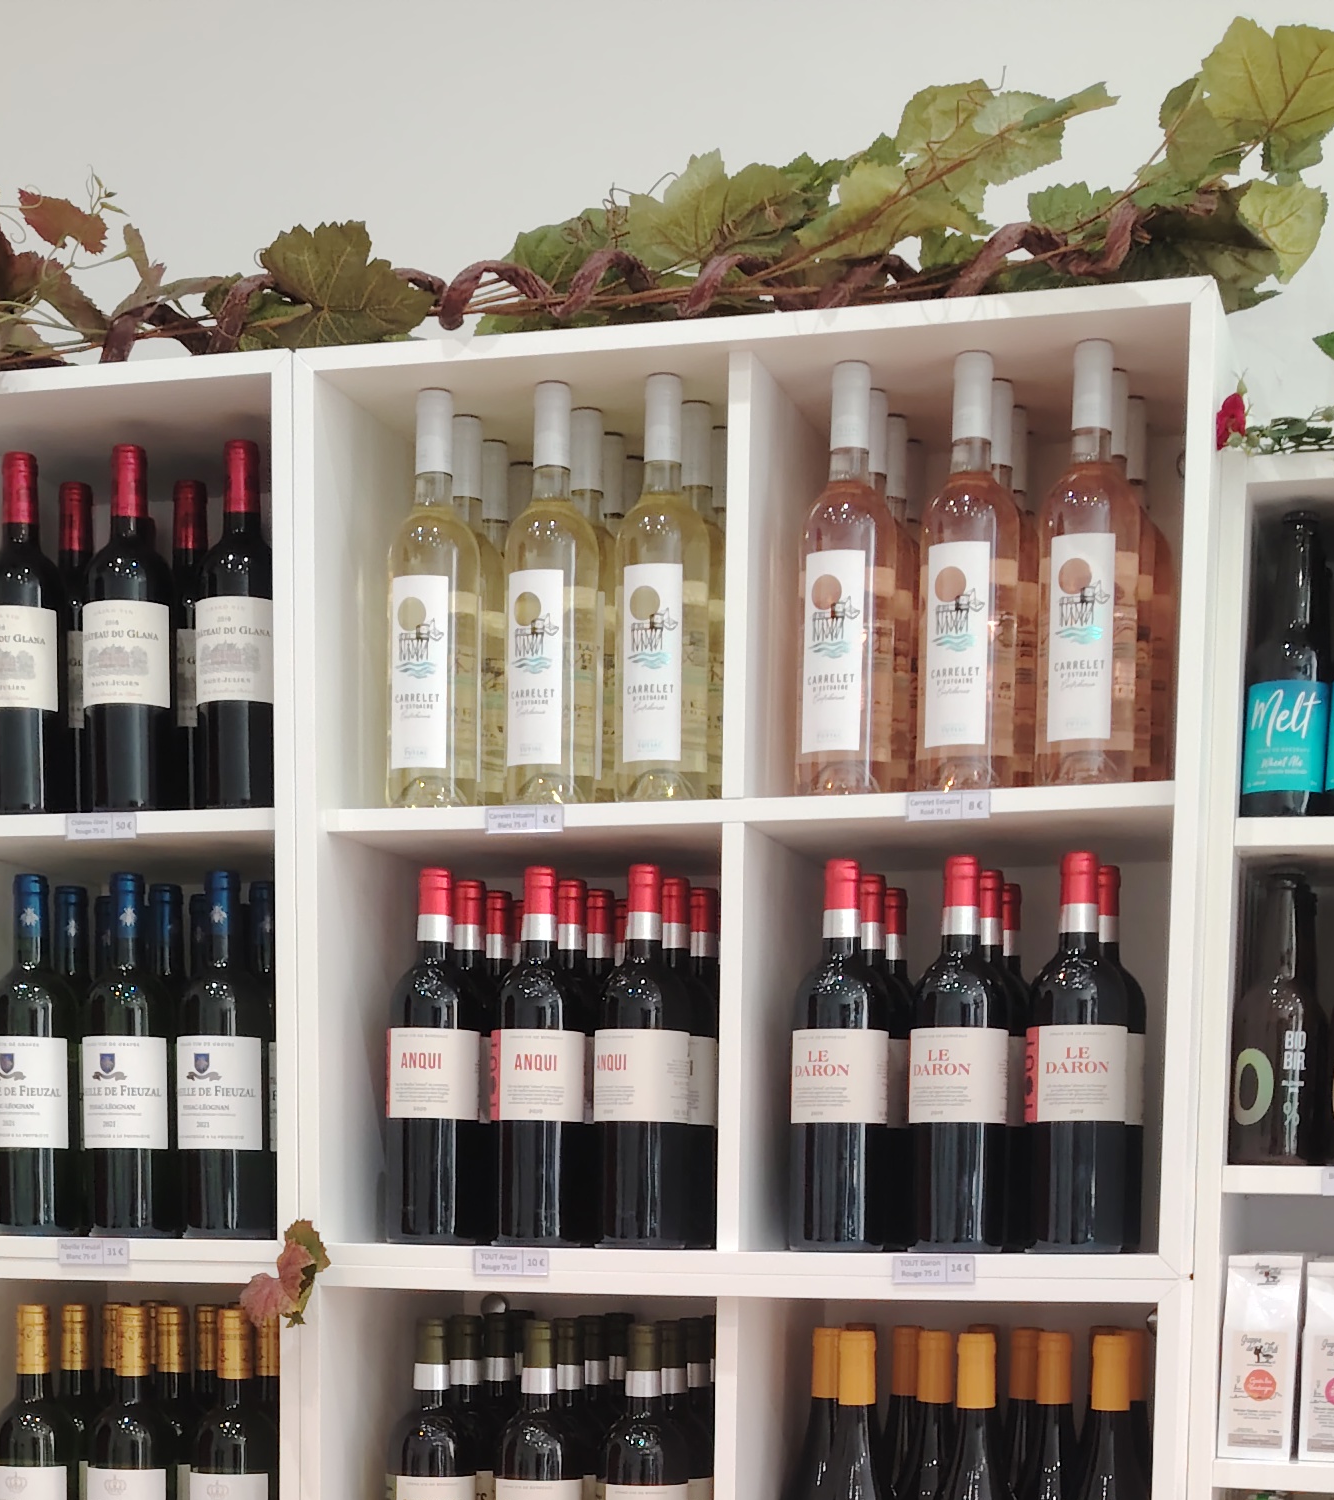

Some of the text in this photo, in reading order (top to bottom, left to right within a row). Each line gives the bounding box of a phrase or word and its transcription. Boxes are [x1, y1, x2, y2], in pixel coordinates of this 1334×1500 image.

[1054, 660, 1105, 671] CARRELET
[931, 667, 980, 678] CARRELET
[627, 684, 674, 694] CARRELET
[1285, 1031, 1306, 1050] BIO
[928, 1049, 949, 1061] LE
[1066, 1047, 1089, 1059] LE
[401, 1053, 442, 1069] ANQUI
[515, 1054, 557, 1071] ANQUI
[597, 1054, 627, 1071] ANQUI
[1045, 1060, 1109, 1074] DARON
[1283, 1052, 1306, 1070] BIR
[914, 1063, 970, 1076] DARON
[20, 1086, 61, 1097] FIEUZAL
[121, 1086, 161, 1097] FIEUZAL
